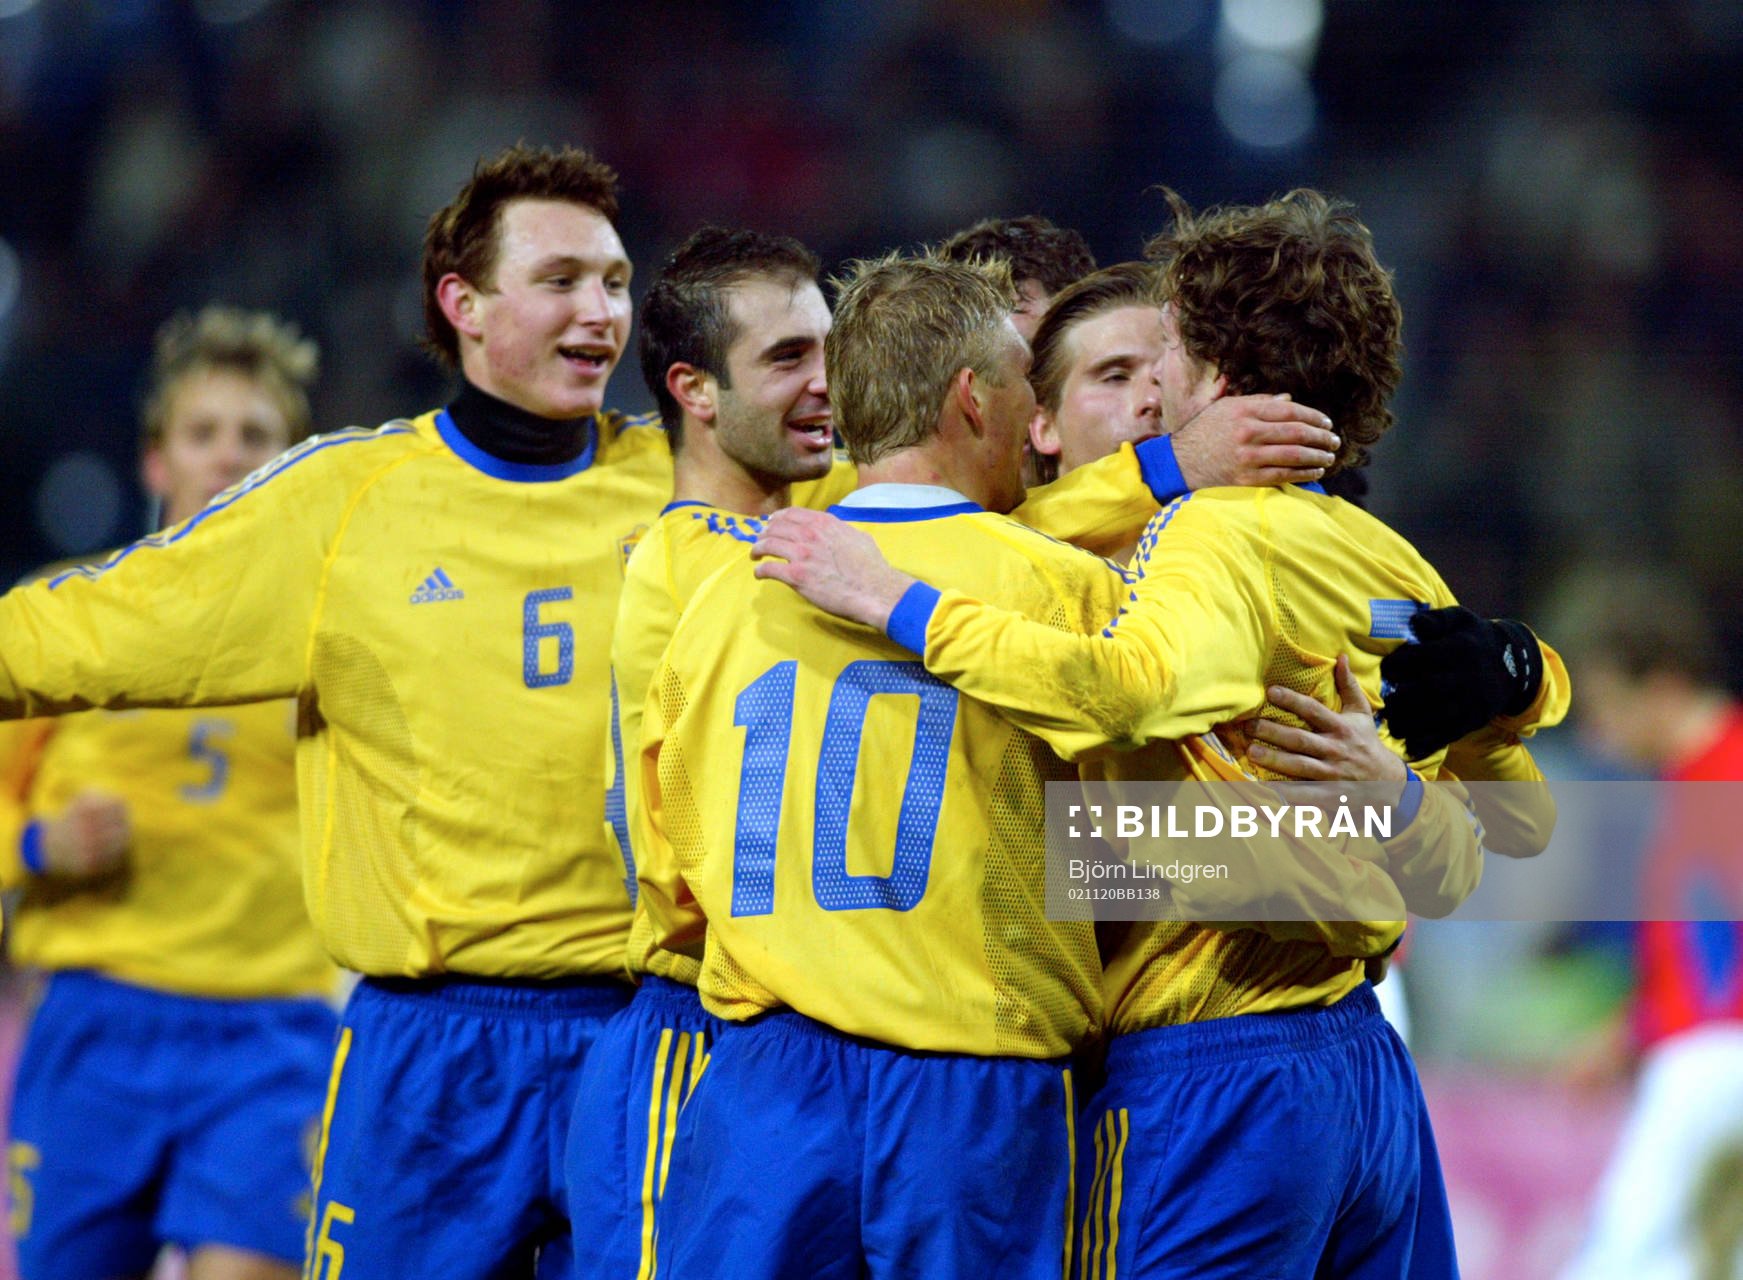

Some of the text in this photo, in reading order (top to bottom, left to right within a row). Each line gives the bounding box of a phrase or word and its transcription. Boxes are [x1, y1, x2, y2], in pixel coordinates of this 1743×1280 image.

[409, 589, 465, 604] adidas
[522, 586, 574, 689] 6
[180, 720, 233, 803] 5
[730, 660, 959, 916] 10
